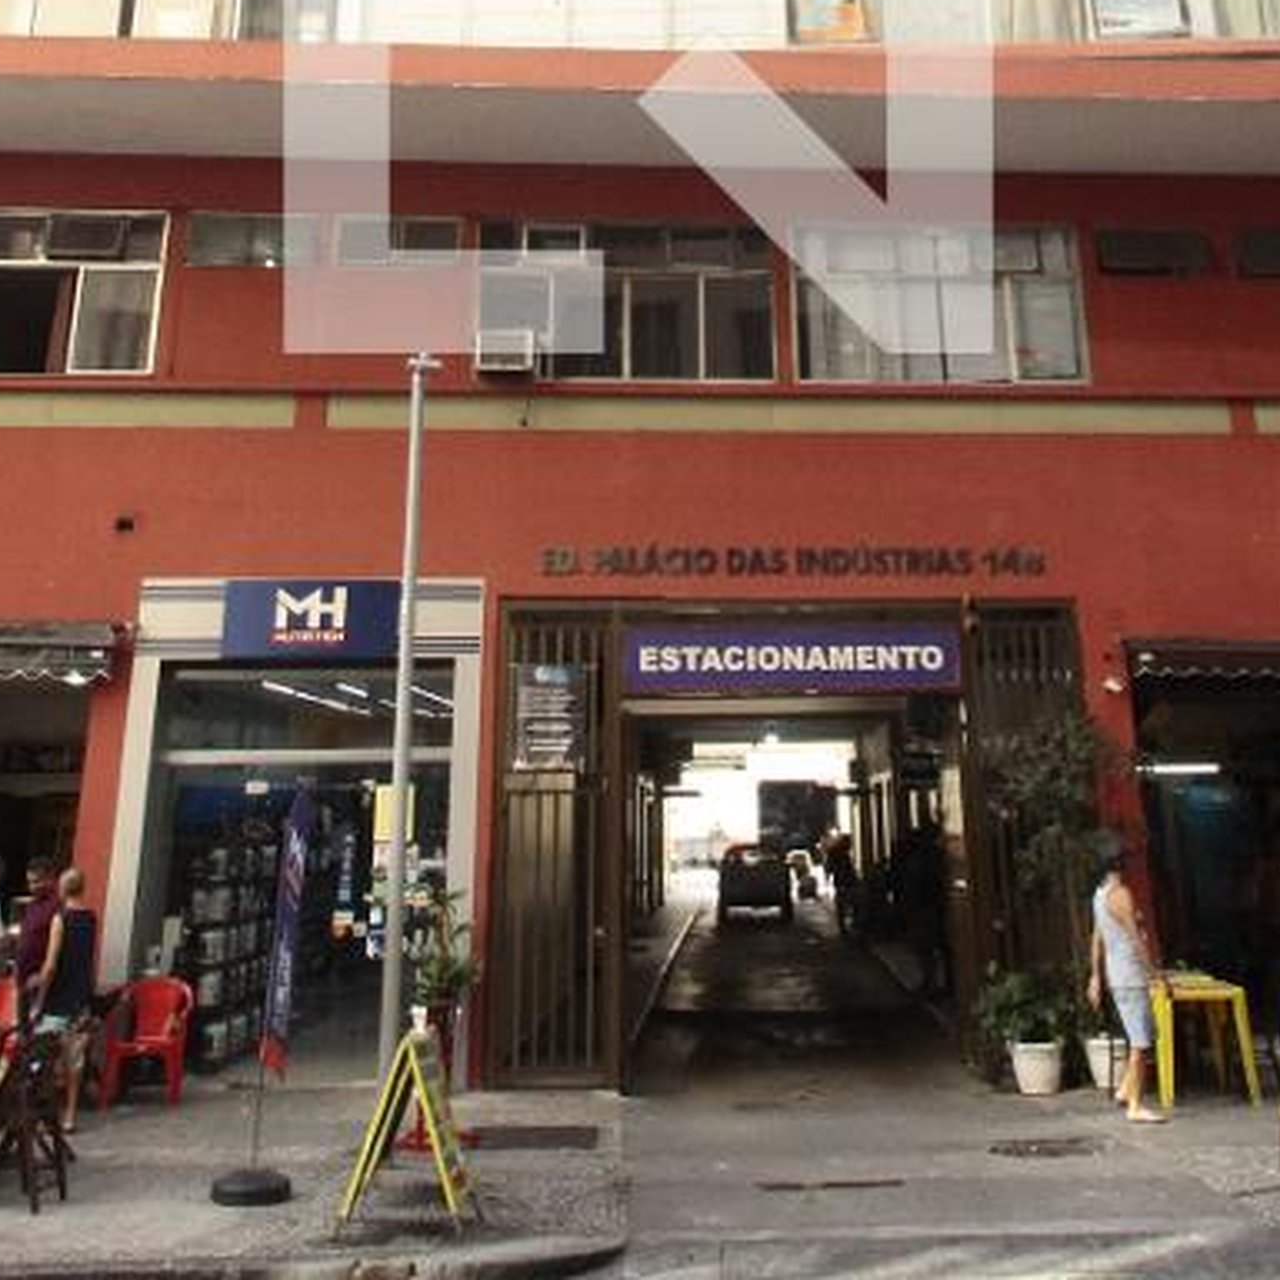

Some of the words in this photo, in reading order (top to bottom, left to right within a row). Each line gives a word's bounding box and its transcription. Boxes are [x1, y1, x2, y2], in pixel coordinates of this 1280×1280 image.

[594, 542, 718, 575] PALÁCIO
[726, 548, 787, 575] DAS
[796, 540, 972, 576] INDÚSTRIAS
[275, 586, 347, 628] MH
[639, 646, 943, 671] ESTACIONAMENTO
